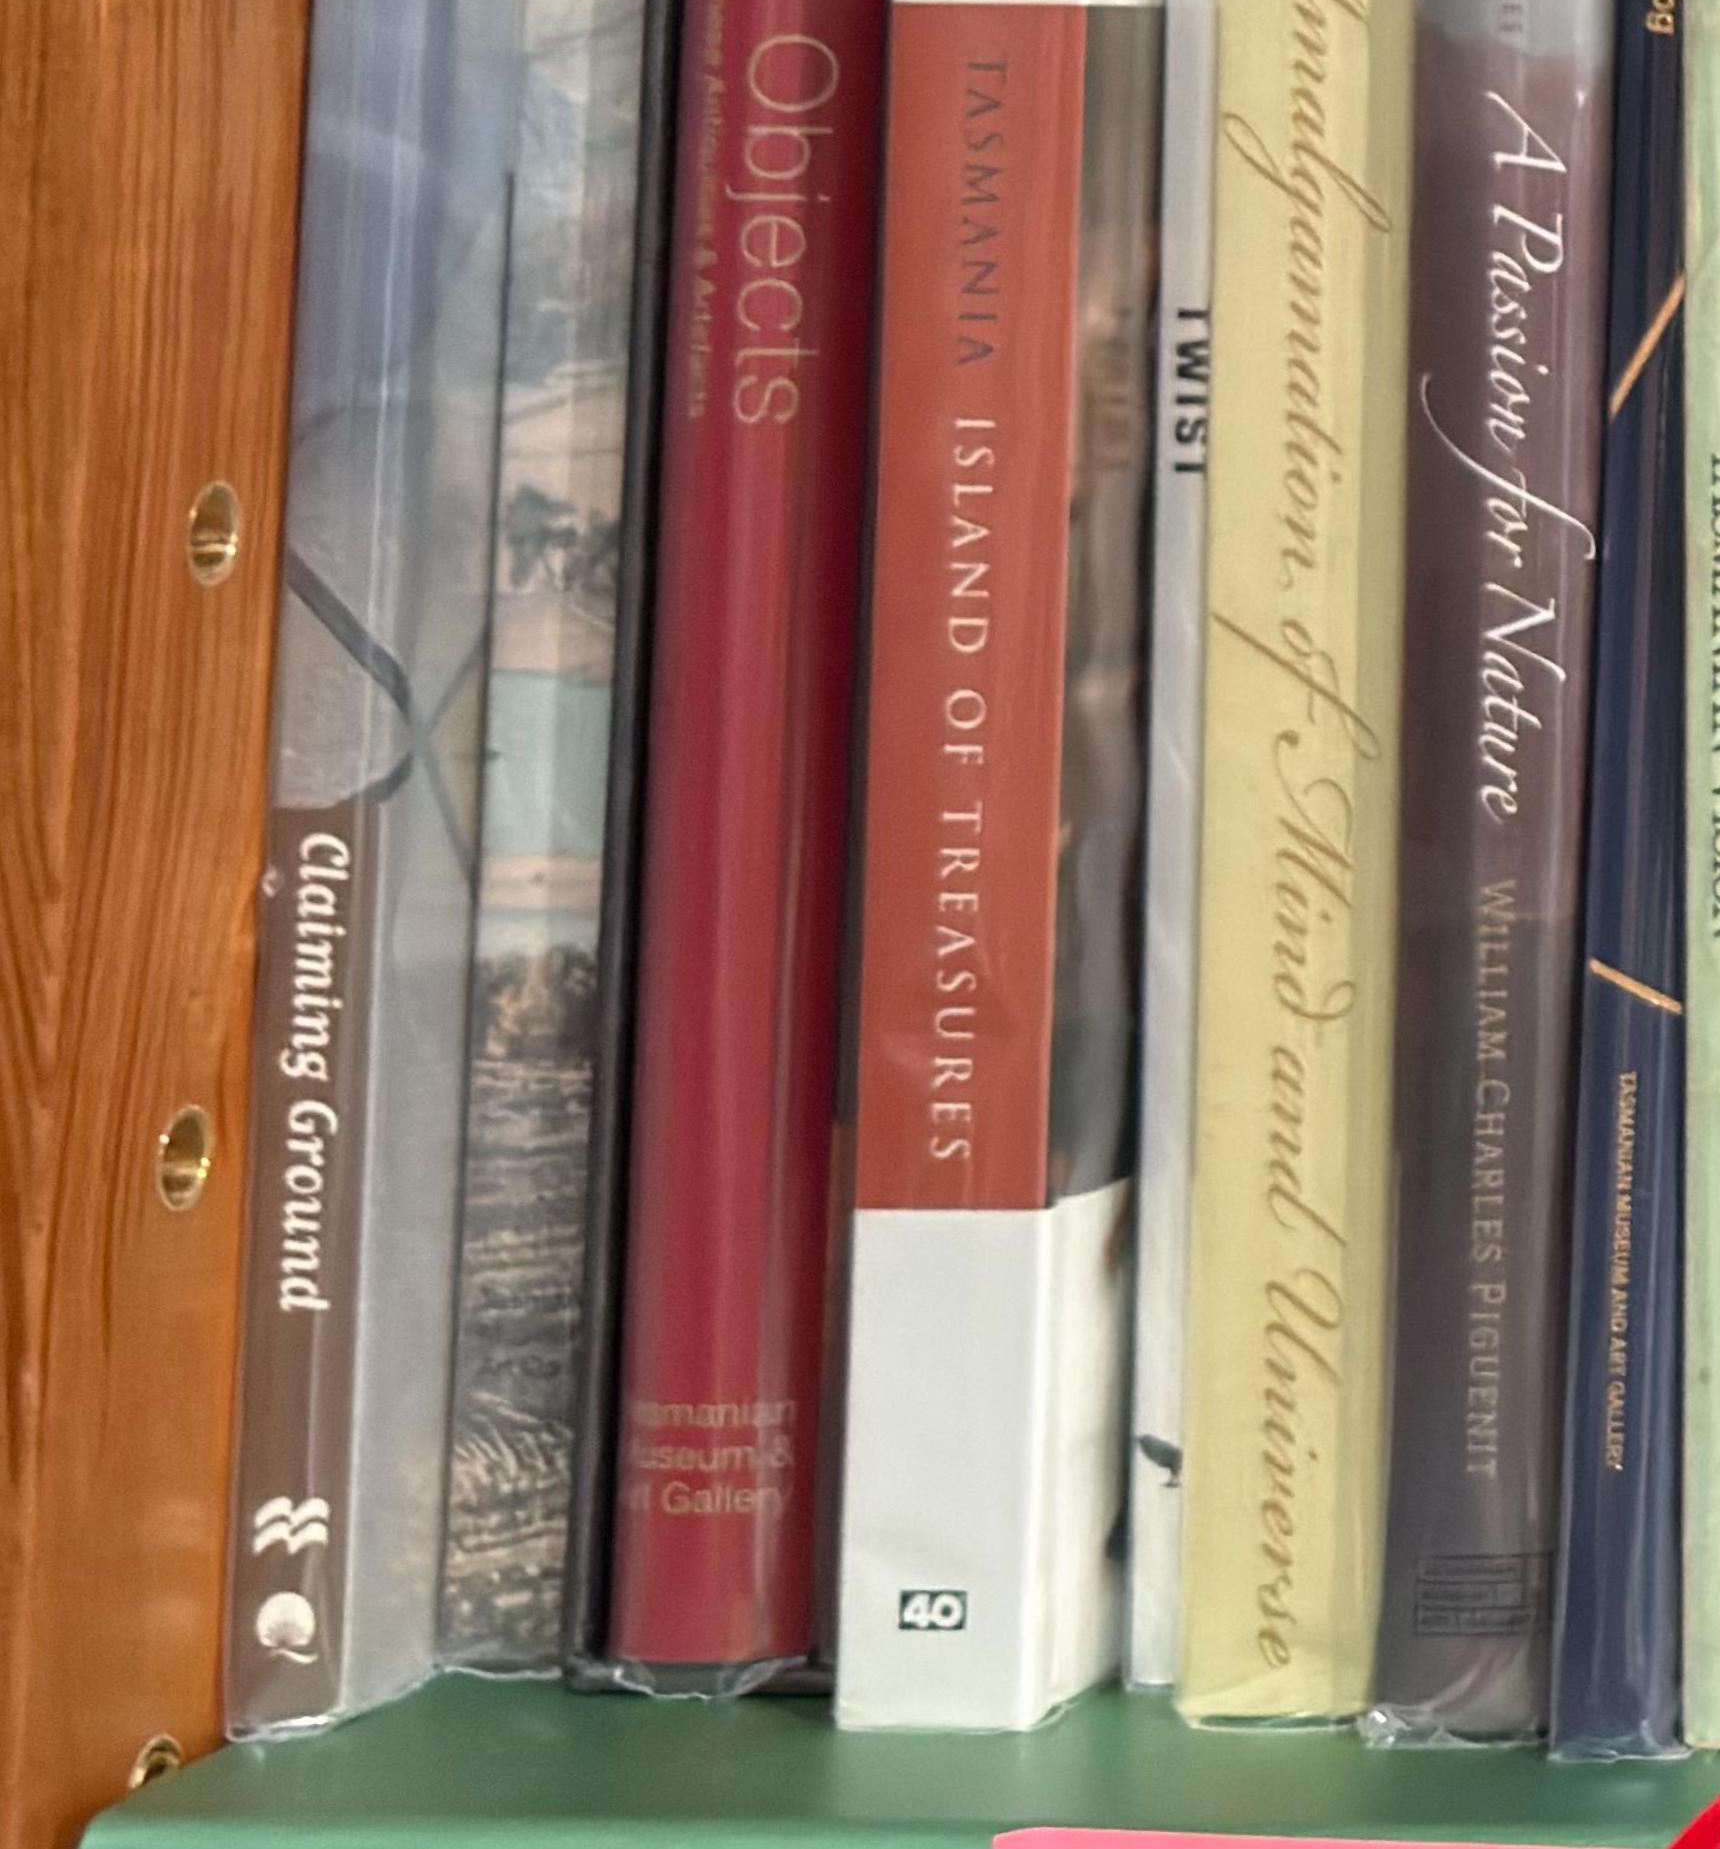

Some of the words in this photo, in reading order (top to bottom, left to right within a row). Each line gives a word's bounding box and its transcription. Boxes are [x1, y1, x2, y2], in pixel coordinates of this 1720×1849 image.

[730, 33, 840, 427] Objects
[956, 52, 1008, 368] TASMANIA
[1174, 309, 1211, 475] TWIST
[1487, 202, 1564, 460] Passion
[948, 416, 998, 655] ISLAND
[1421, 372, 1597, 568] for
[943, 688, 988, 768] OF
[1480, 580, 1566, 824] Nature
[281, 832, 350, 1082] Claiming
[929, 802, 982, 1162] TREASURES
[1272, 732, 1358, 1020] Mind
[280, 1098, 339, 1312] Ground
[1263, 1042, 1346, 1237] and
[1611, 1194, 1634, 1284] MUSEUM
[1615, 1071, 1638, 1190] TASMANIAN
[1609, 1288, 1631, 1334] AND
[1256, 1264, 1343, 1670] Universe
[1604, 1380, 1625, 1471] GALLERY
